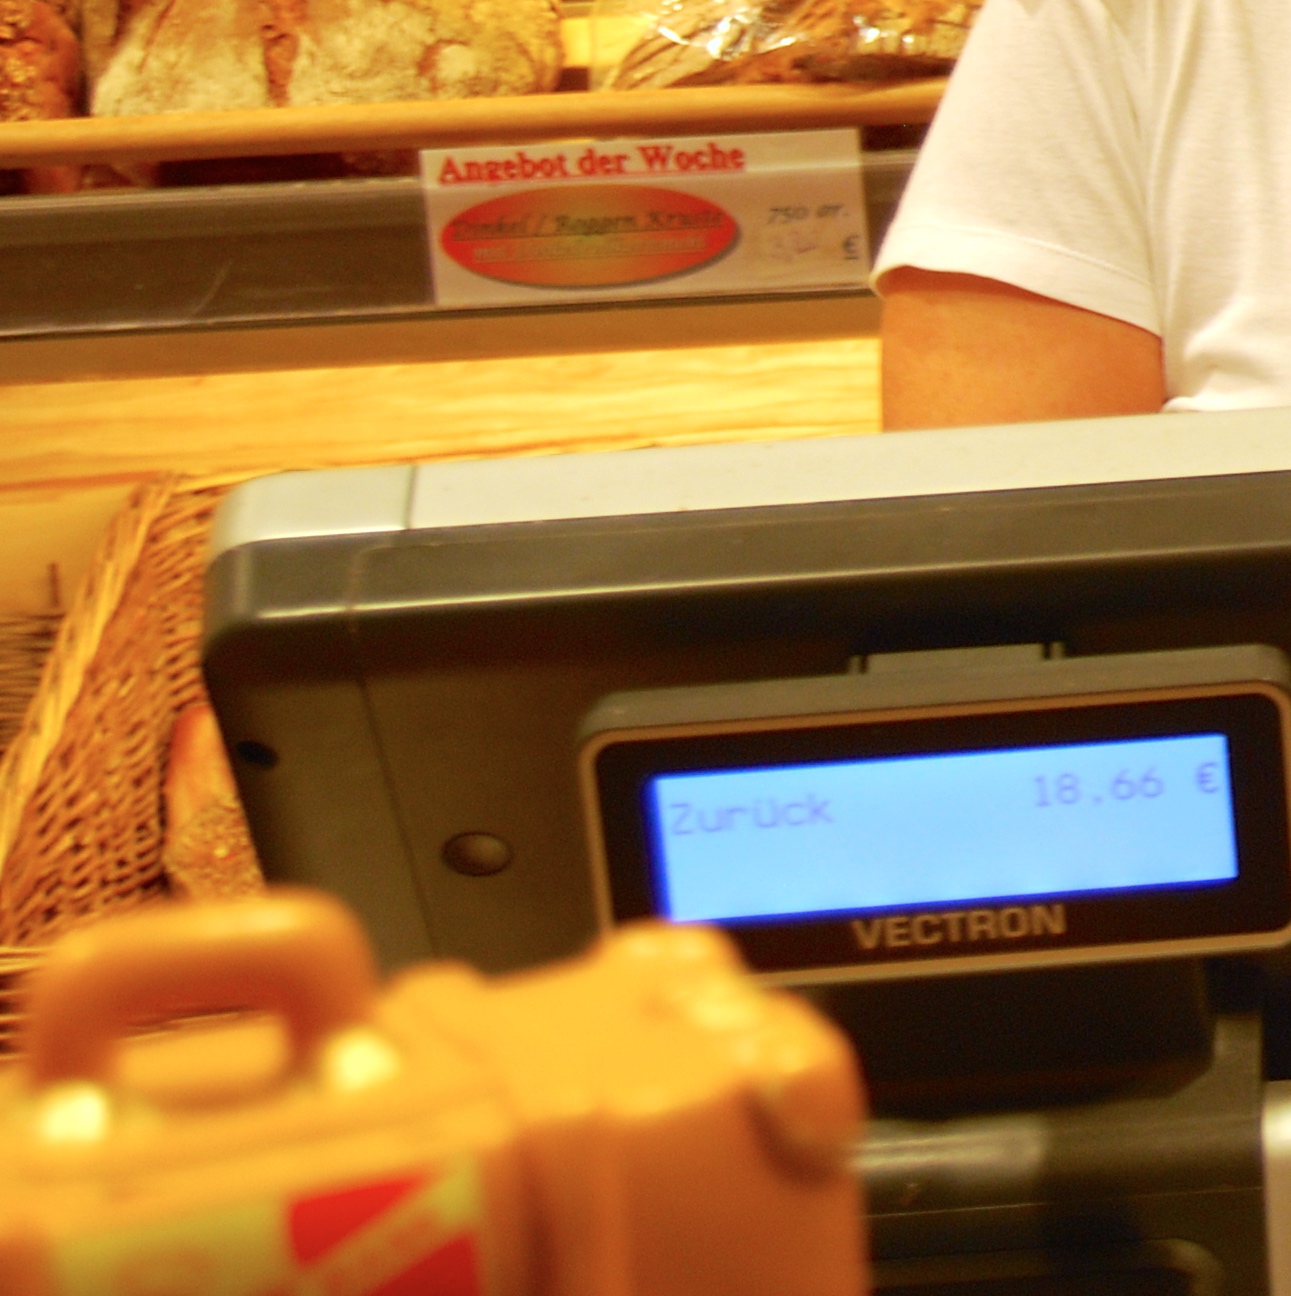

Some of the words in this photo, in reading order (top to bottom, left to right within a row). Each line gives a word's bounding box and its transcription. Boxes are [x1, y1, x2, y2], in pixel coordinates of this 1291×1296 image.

[439, 151, 570, 186] Angebot
[577, 147, 629, 178] der
[636, 142, 746, 174] Woche
[671, 792, 835, 836] Zurück
[1033, 766, 1164, 809] 18.66
[1195, 761, 1221, 795] €
[851, 904, 1068, 949] VECTRON
